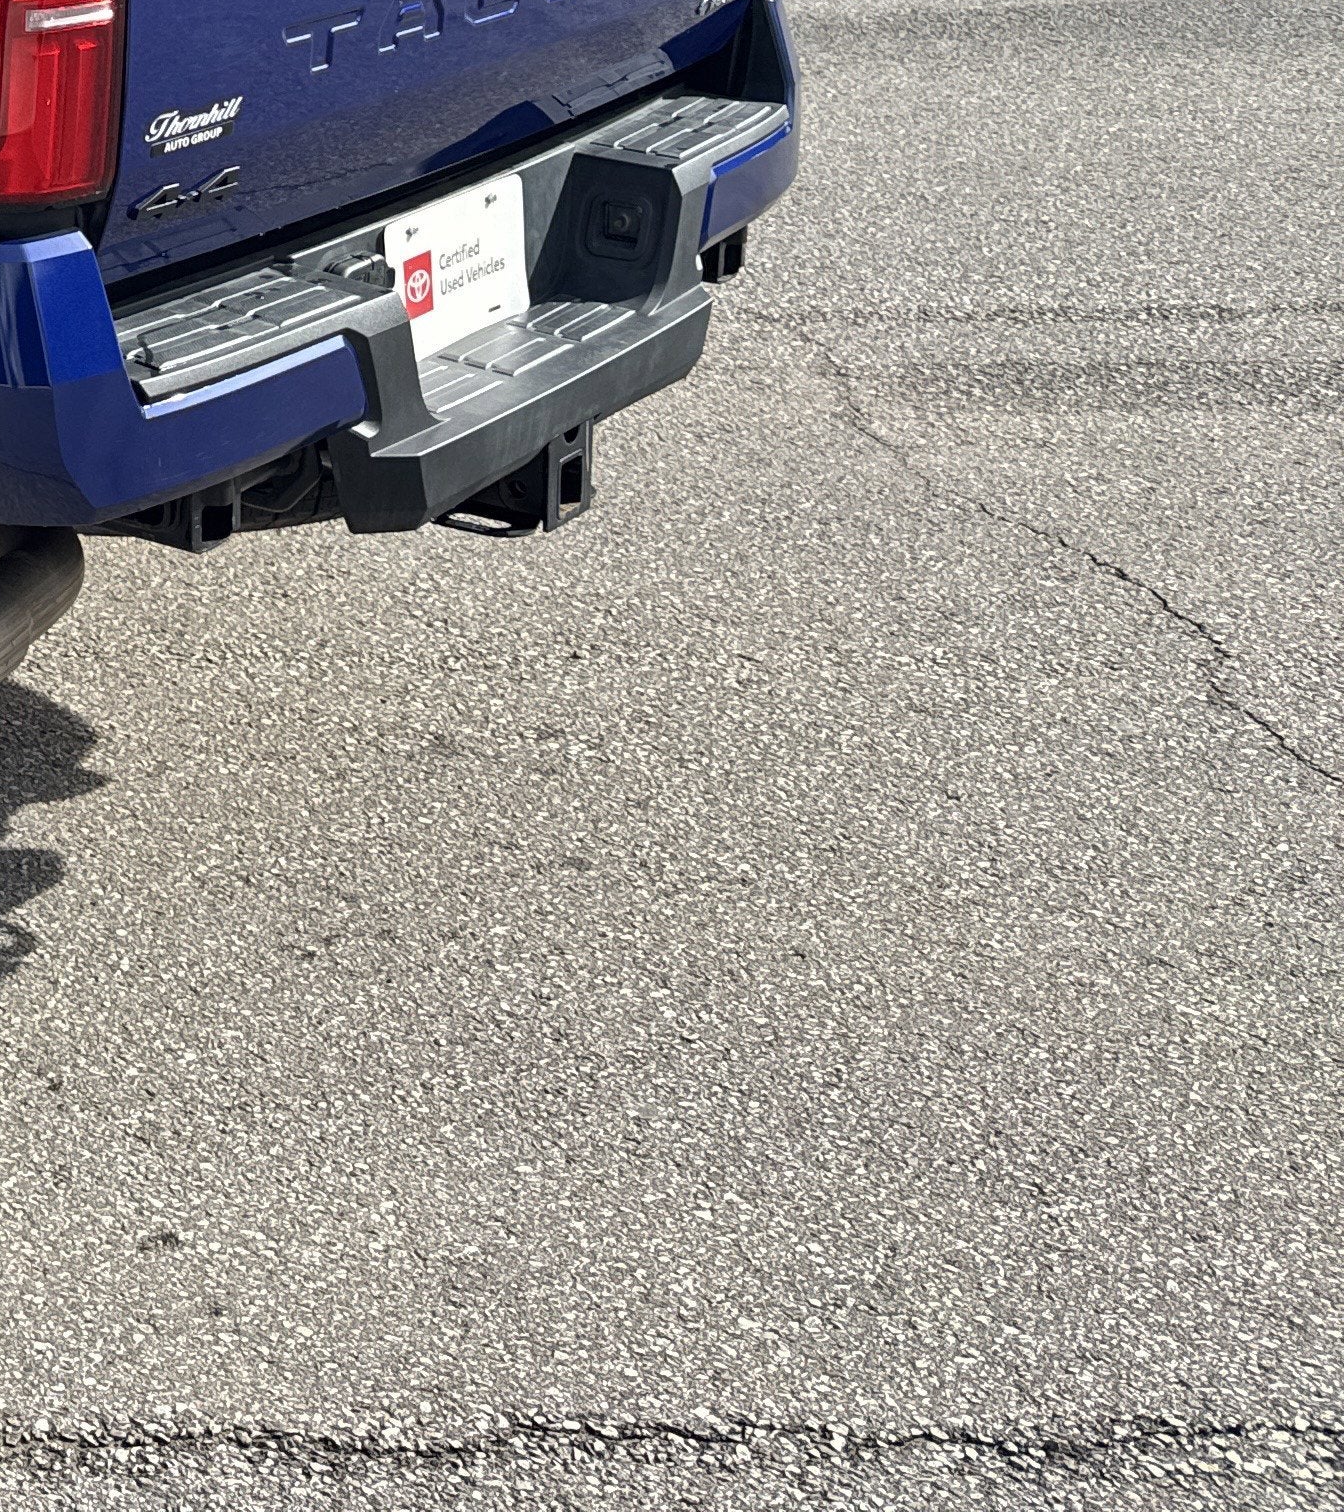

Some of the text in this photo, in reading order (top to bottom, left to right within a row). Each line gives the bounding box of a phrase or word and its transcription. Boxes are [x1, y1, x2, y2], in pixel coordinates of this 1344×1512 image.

[144, 95, 244, 143] Thornhill
[163, 126, 224, 154] AUTO GROUP
[438, 237, 480, 271] Certified
[439, 256, 506, 296] Used Vehicles
